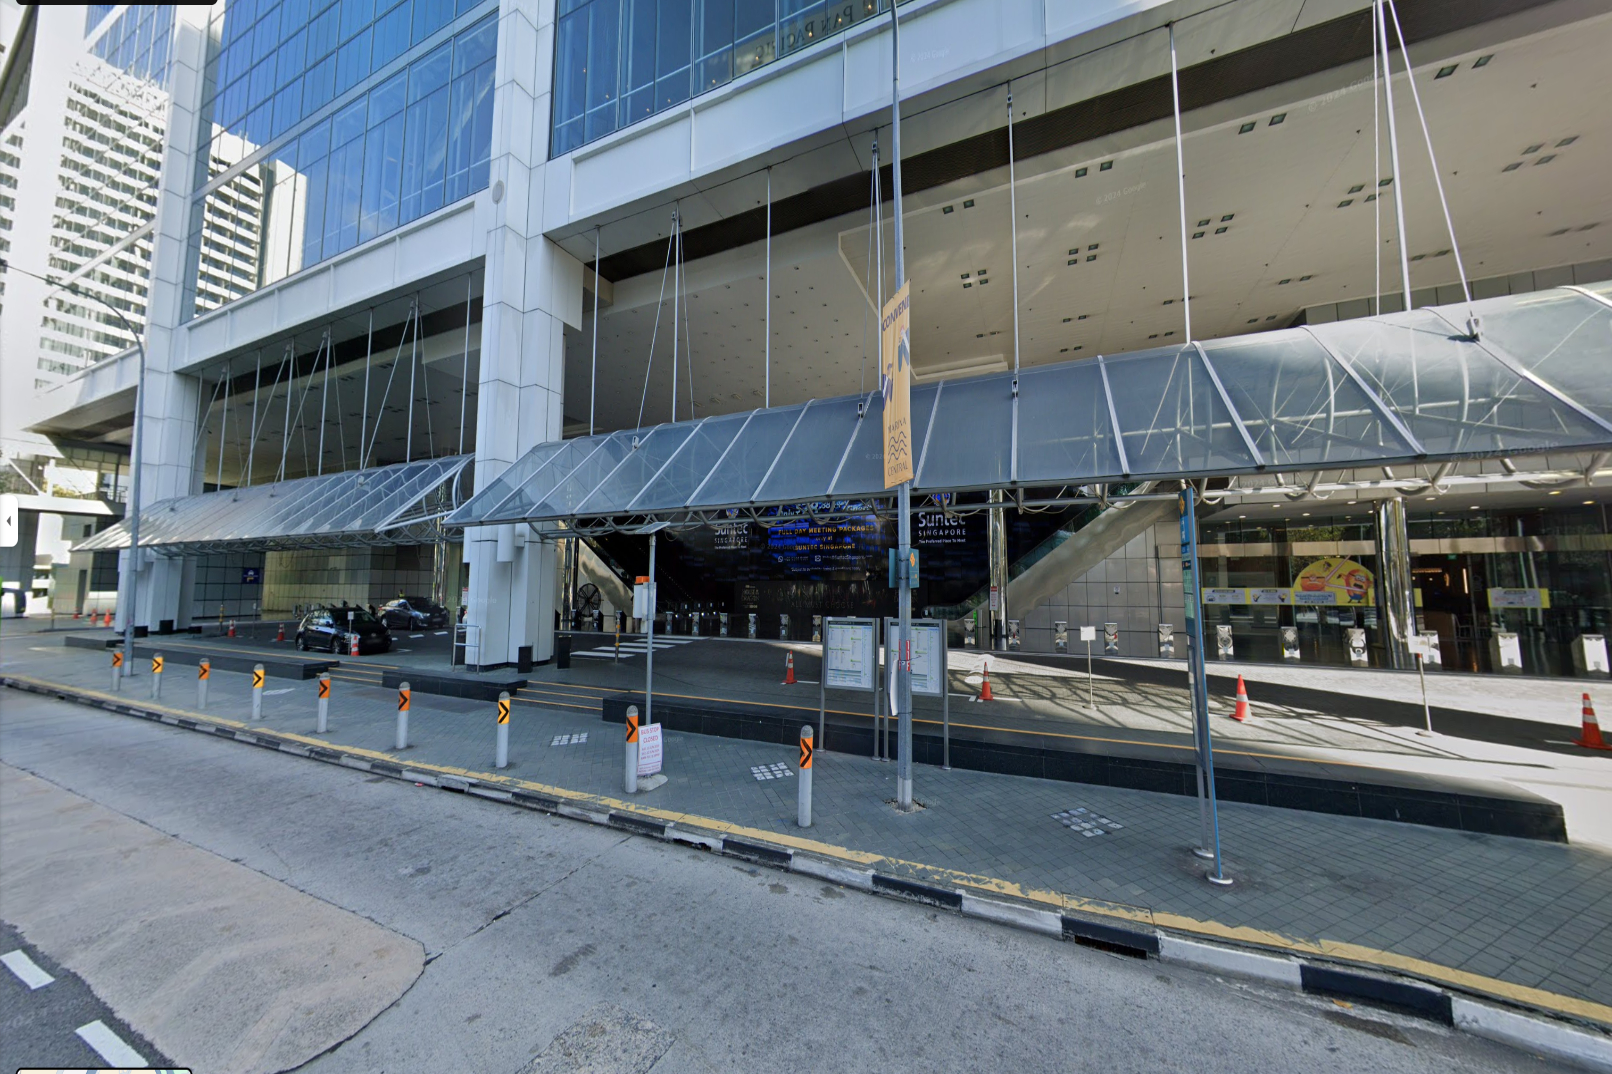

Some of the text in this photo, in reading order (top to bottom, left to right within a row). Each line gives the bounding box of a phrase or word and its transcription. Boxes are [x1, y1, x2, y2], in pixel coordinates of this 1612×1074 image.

[887, 416, 907, 434] MARINA
[887, 460, 908, 477] CENTRAL
[918, 511, 966, 528] Suntec
[808, 526, 837, 534] MEETING
[839, 524, 874, 533] PACKAGES
[918, 528, 966, 537] SINGAPORE
[819, 542, 856, 550] SINGAPORE
